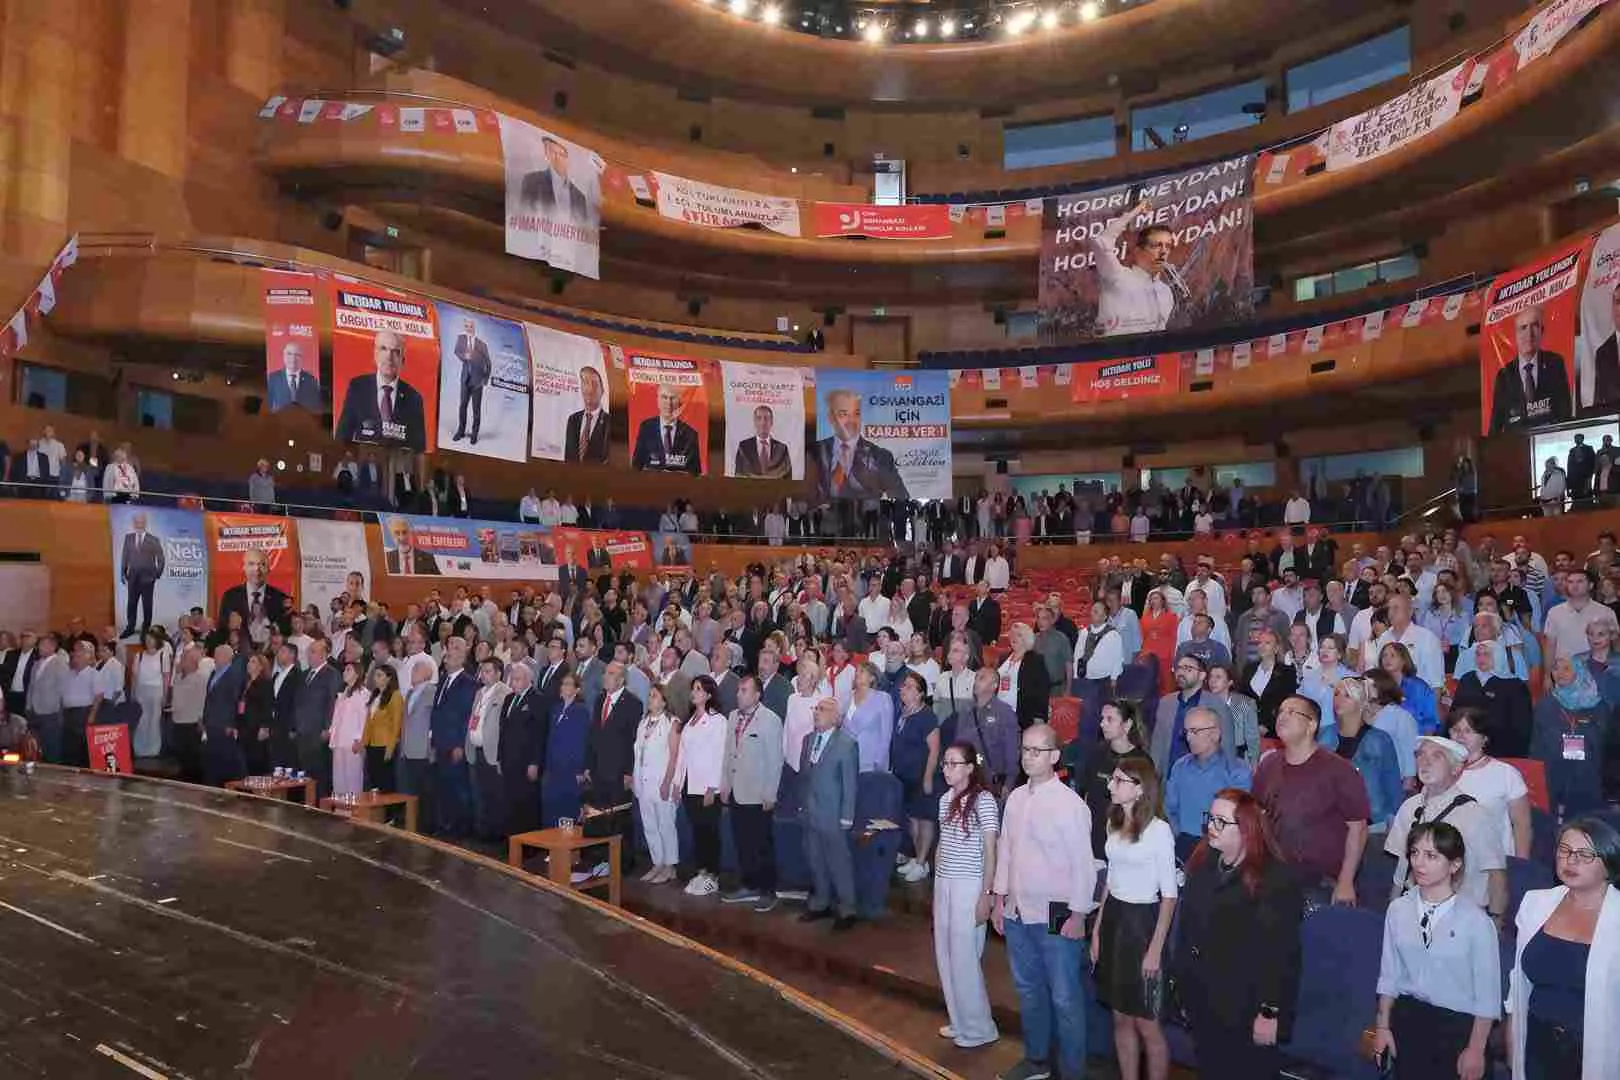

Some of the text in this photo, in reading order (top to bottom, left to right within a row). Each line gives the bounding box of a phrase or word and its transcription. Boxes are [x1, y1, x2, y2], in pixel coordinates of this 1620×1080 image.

[1139, 155, 1248, 200] MEYDAN!
[1055, 179, 1245, 243] HOD MEYDAN!
[869, 393, 945, 406] OSMANGAZİ
[895, 408, 920, 423] İÇİN
[867, 426, 909, 438] KARAR
